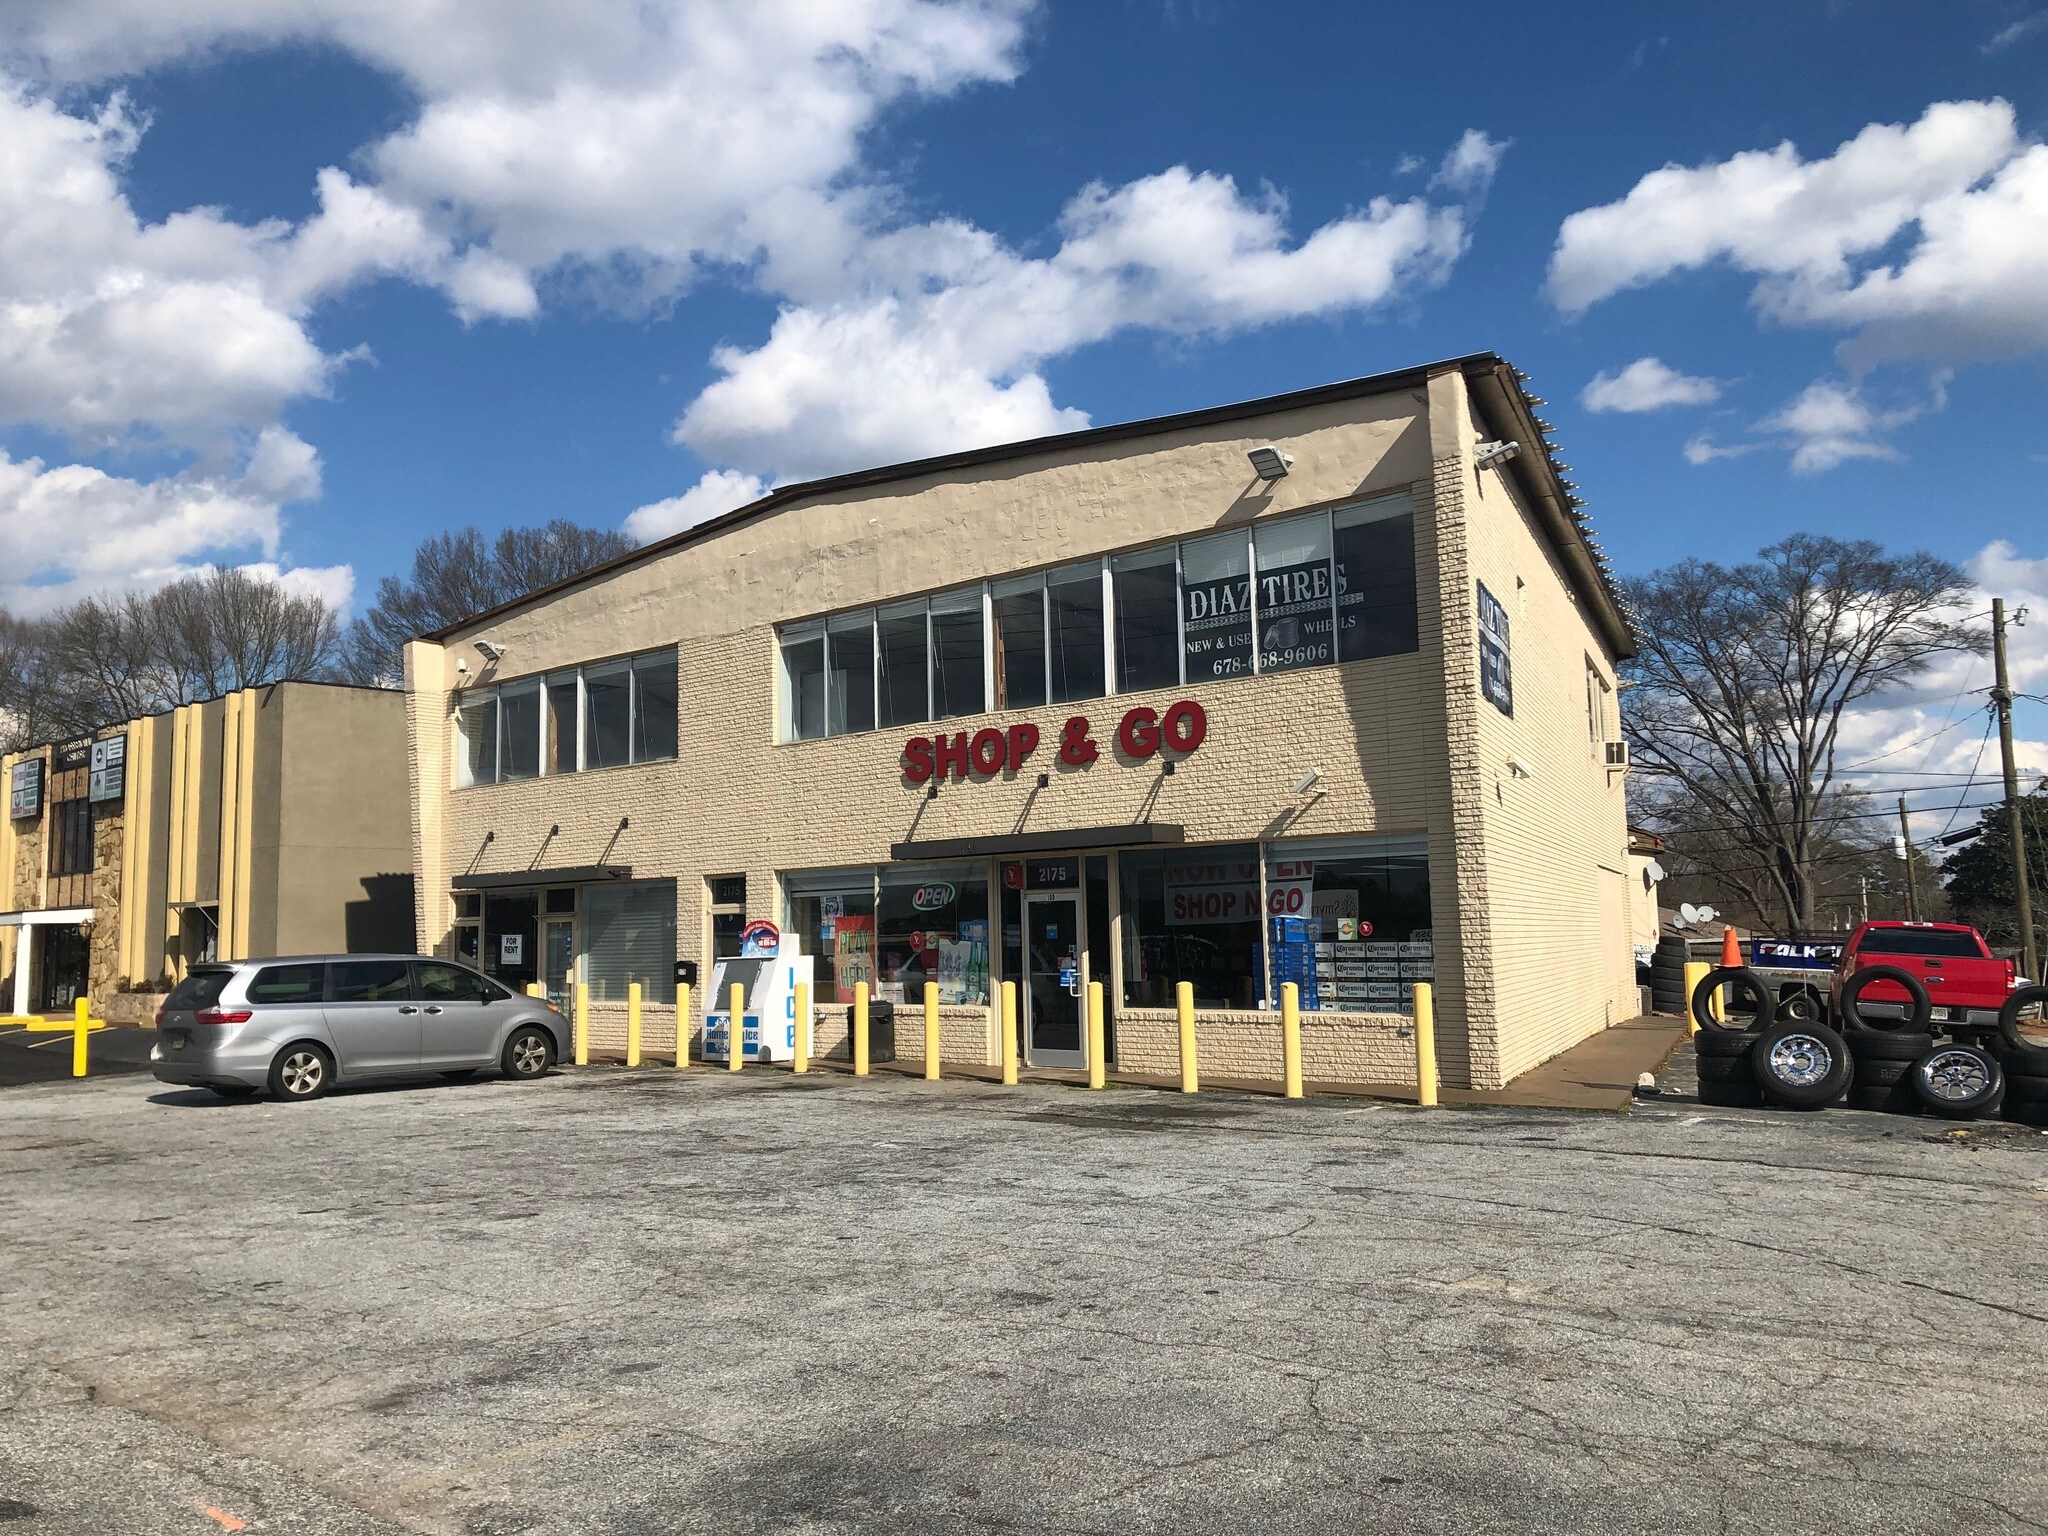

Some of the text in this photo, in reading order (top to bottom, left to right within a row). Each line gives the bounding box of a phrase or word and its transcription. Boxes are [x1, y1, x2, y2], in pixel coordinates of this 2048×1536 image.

[1190, 564, 1348, 619] DIAZ TIRES
[1187, 615, 1356, 654] NEW & USE WHELS
[904, 700, 1207, 782] SHOP & GO
[1039, 867, 1066, 881] 2175
[723, 886, 740, 897] 2175
[916, 888, 950, 905] OPEN
[1173, 888, 1304, 919] SHOP N GO
[504, 946, 519, 954] RENT
[838, 930, 872, 954] PLAY
[839, 966, 873, 989] HERE
[706, 1029, 728, 1040] Home
[745, 1030, 759, 1040] Ice
